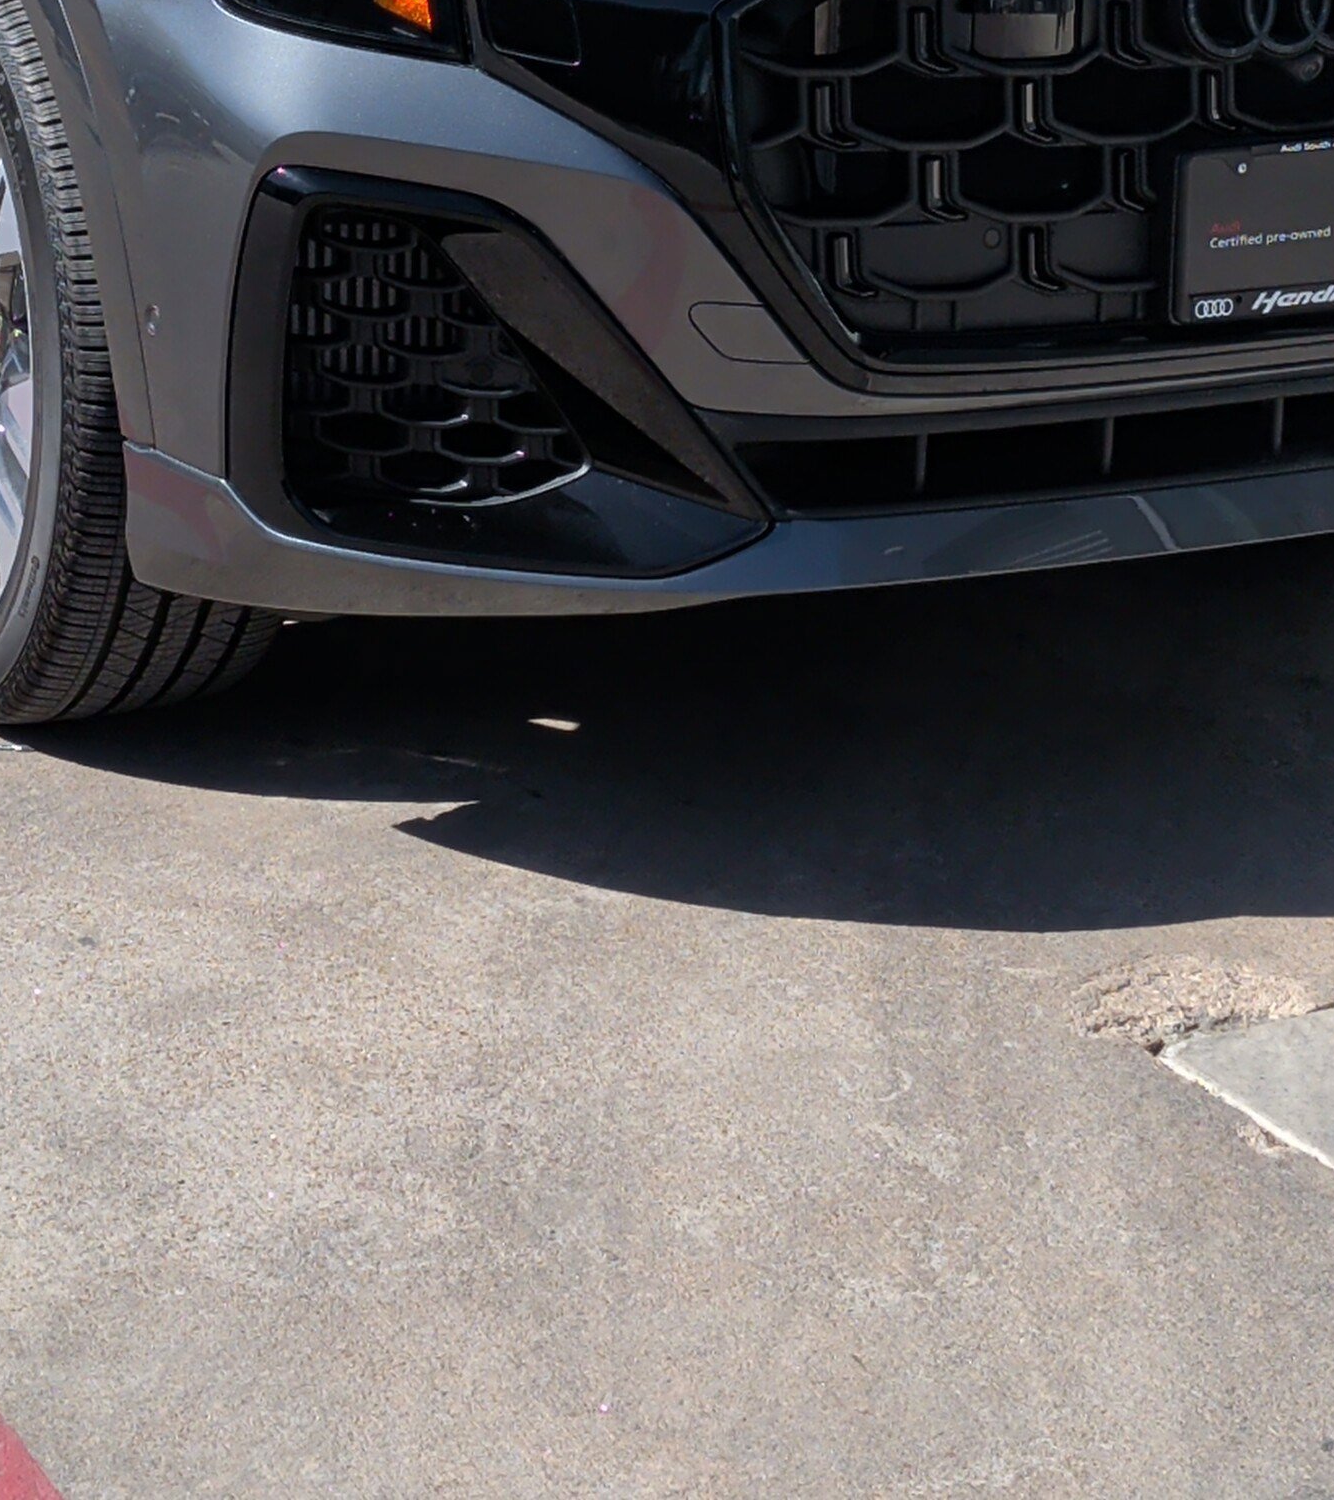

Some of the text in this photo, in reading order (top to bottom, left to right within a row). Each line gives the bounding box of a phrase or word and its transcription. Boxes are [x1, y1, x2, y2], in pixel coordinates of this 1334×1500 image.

[1280, 144, 1303, 152] Audi
[1304, 141, 1331, 151] South
[1209, 226, 1332, 249] Certified pre-owned
